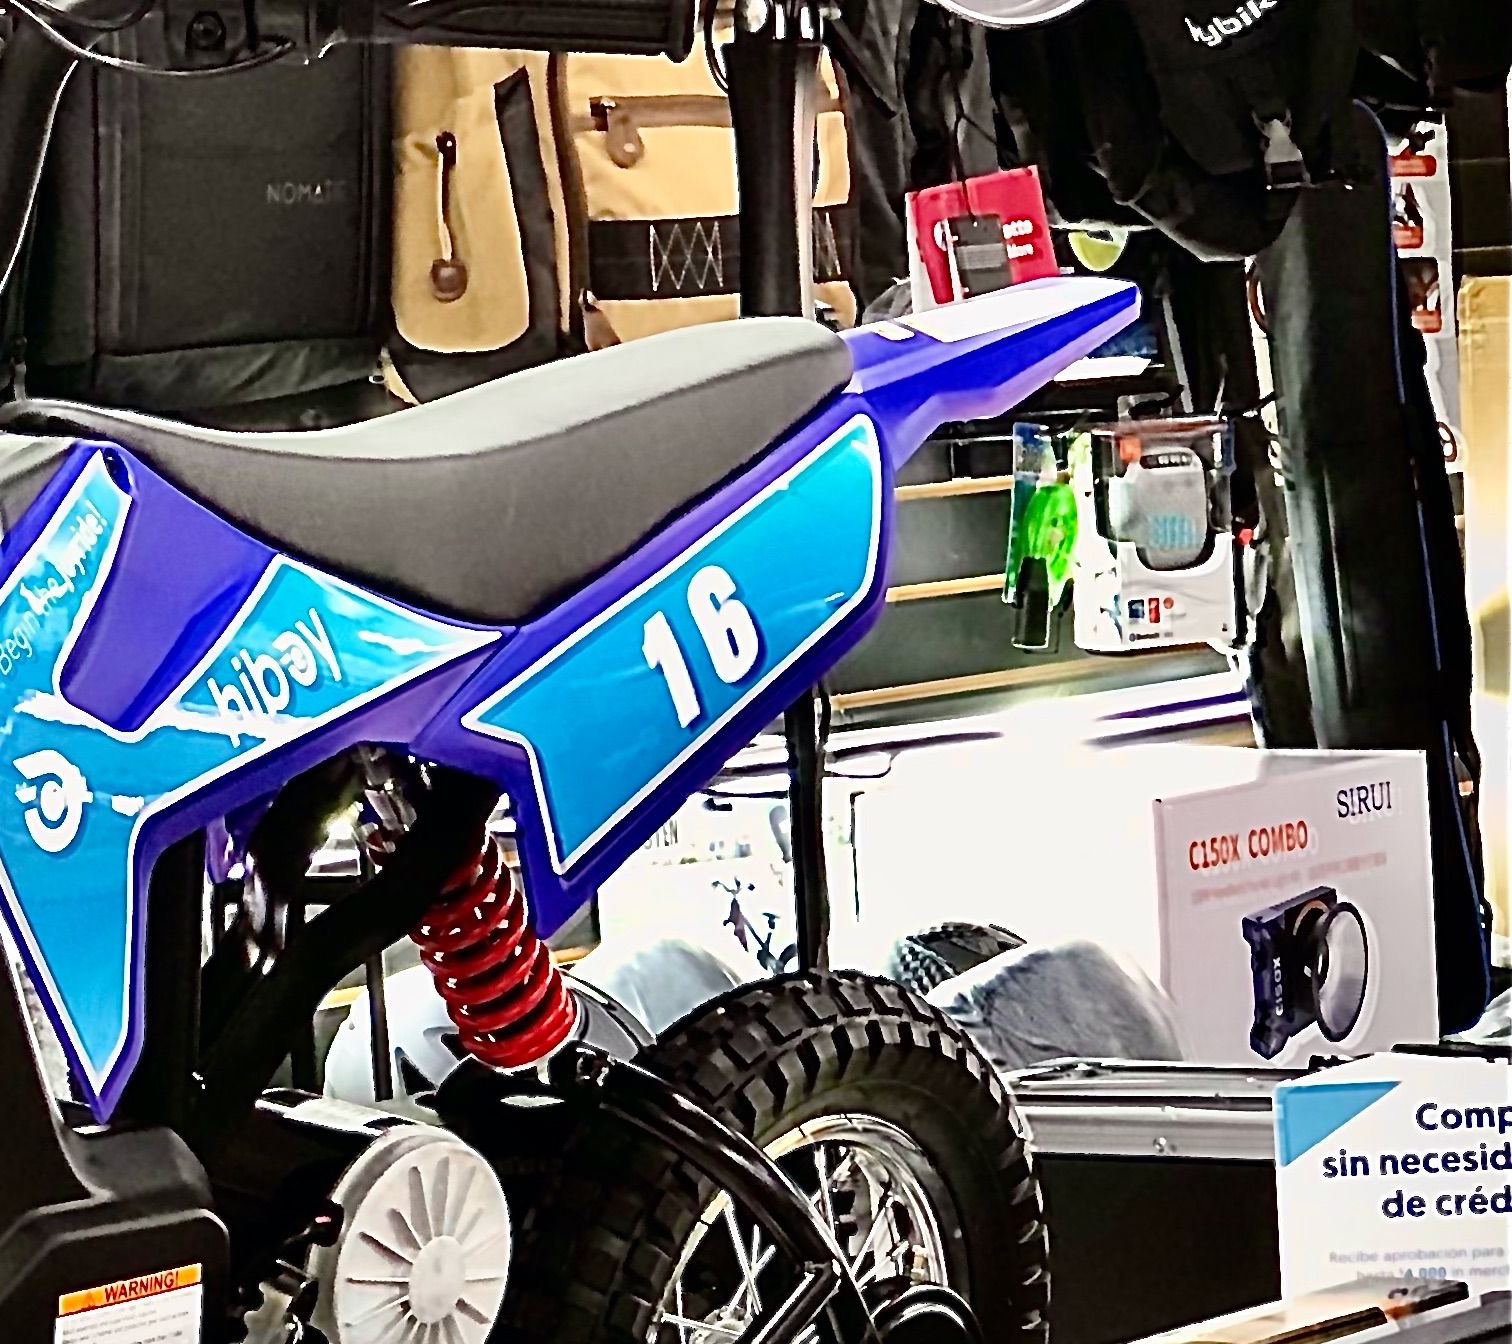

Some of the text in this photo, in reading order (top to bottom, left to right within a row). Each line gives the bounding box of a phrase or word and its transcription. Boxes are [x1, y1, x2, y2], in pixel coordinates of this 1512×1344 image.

[642, 565, 759, 729] 16
[1337, 781, 1392, 819] SIRUI
[1189, 820, 1309, 871] C150X COMBO
[1415, 1102, 1512, 1135] Comp
[1322, 1142, 1512, 1178] sin necesid
[1381, 1185, 1512, 1218] de créd
[104, 1270, 180, 1303] WARNING!
